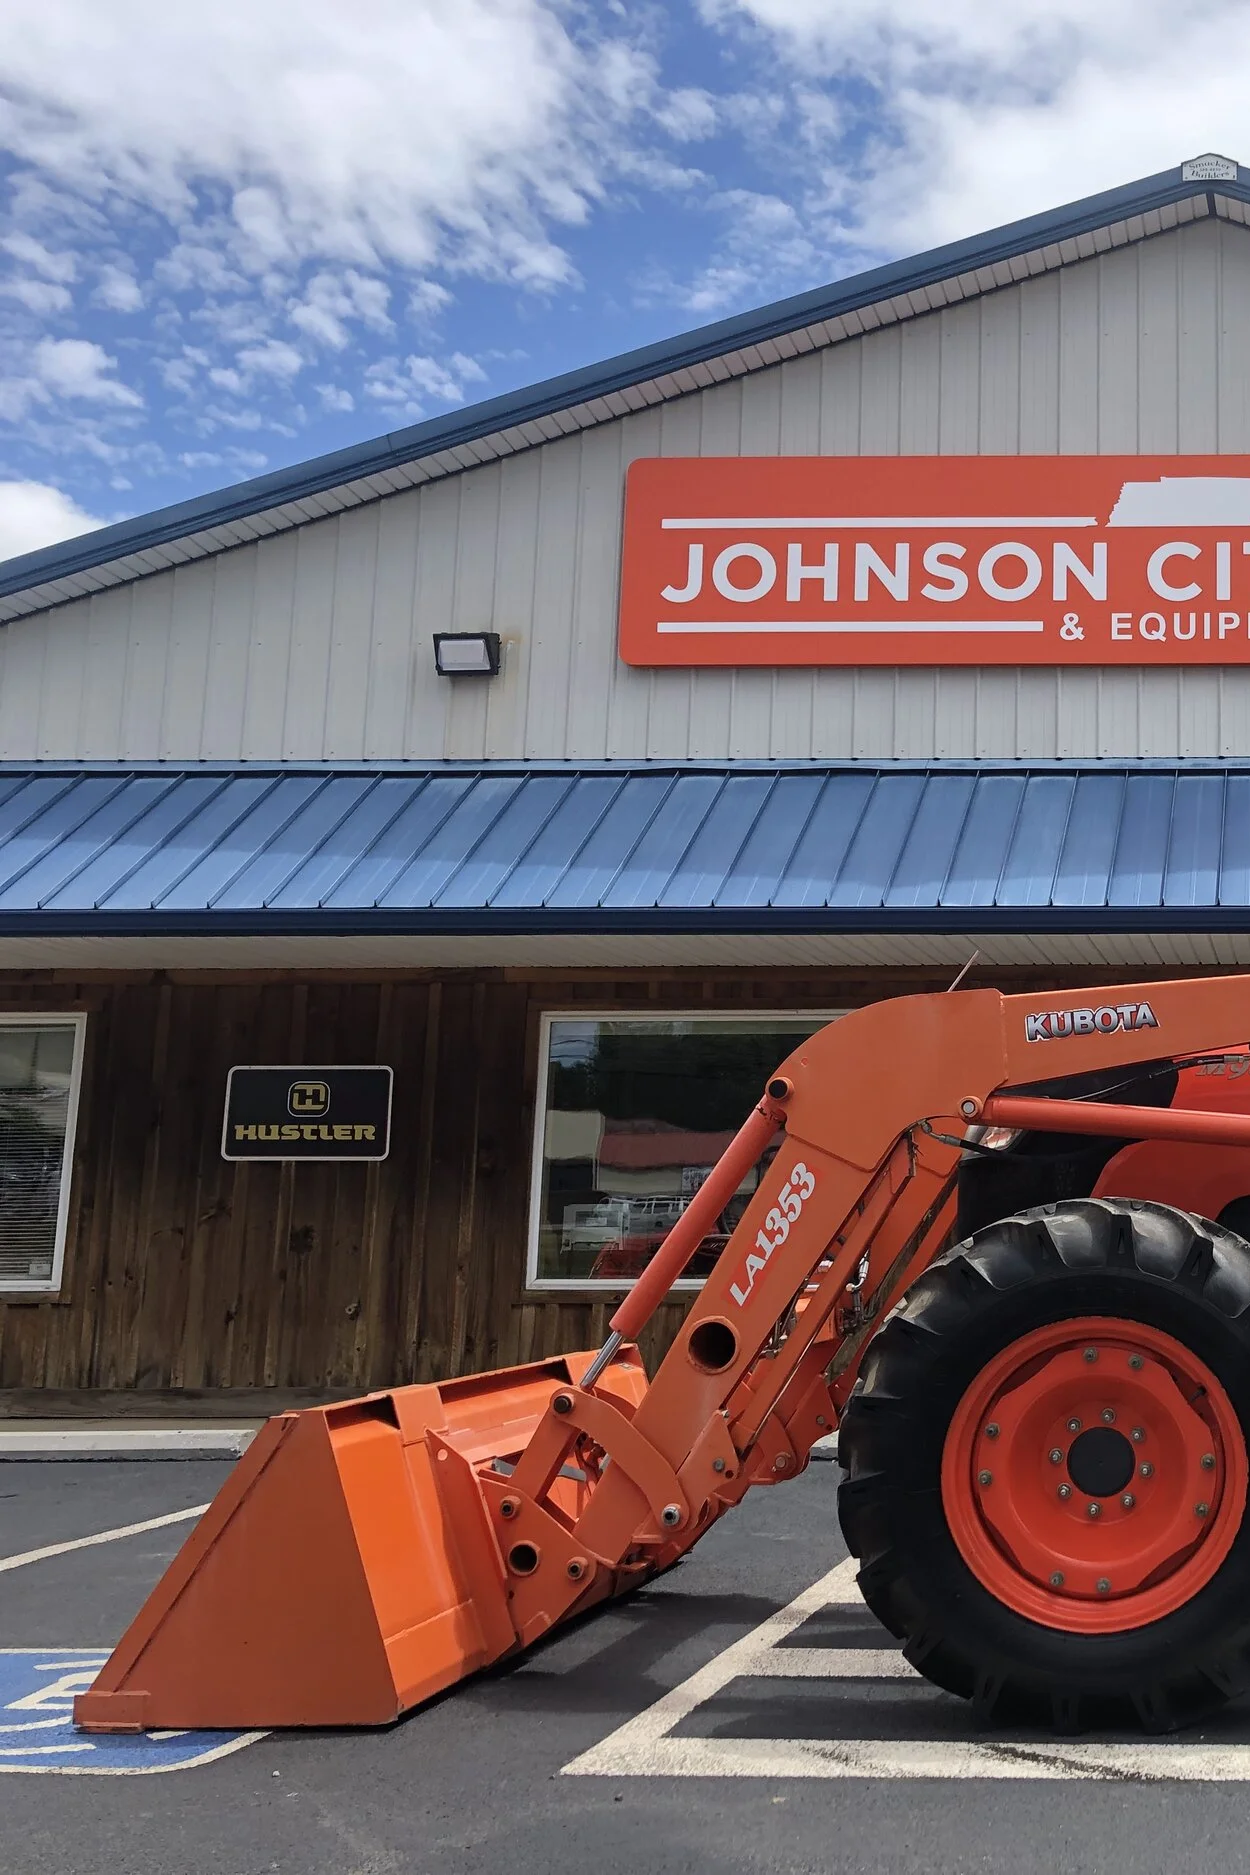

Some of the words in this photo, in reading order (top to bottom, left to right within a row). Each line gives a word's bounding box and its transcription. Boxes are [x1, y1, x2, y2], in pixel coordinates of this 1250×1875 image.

[660, 541, 1108, 603] JOHNSON
[1059, 612, 1086, 641] &
[1026, 1002, 1160, 1042] KUBOTA
[234, 1124, 376, 1141] HUSTLER
[728, 1162, 816, 1307] LA1353
